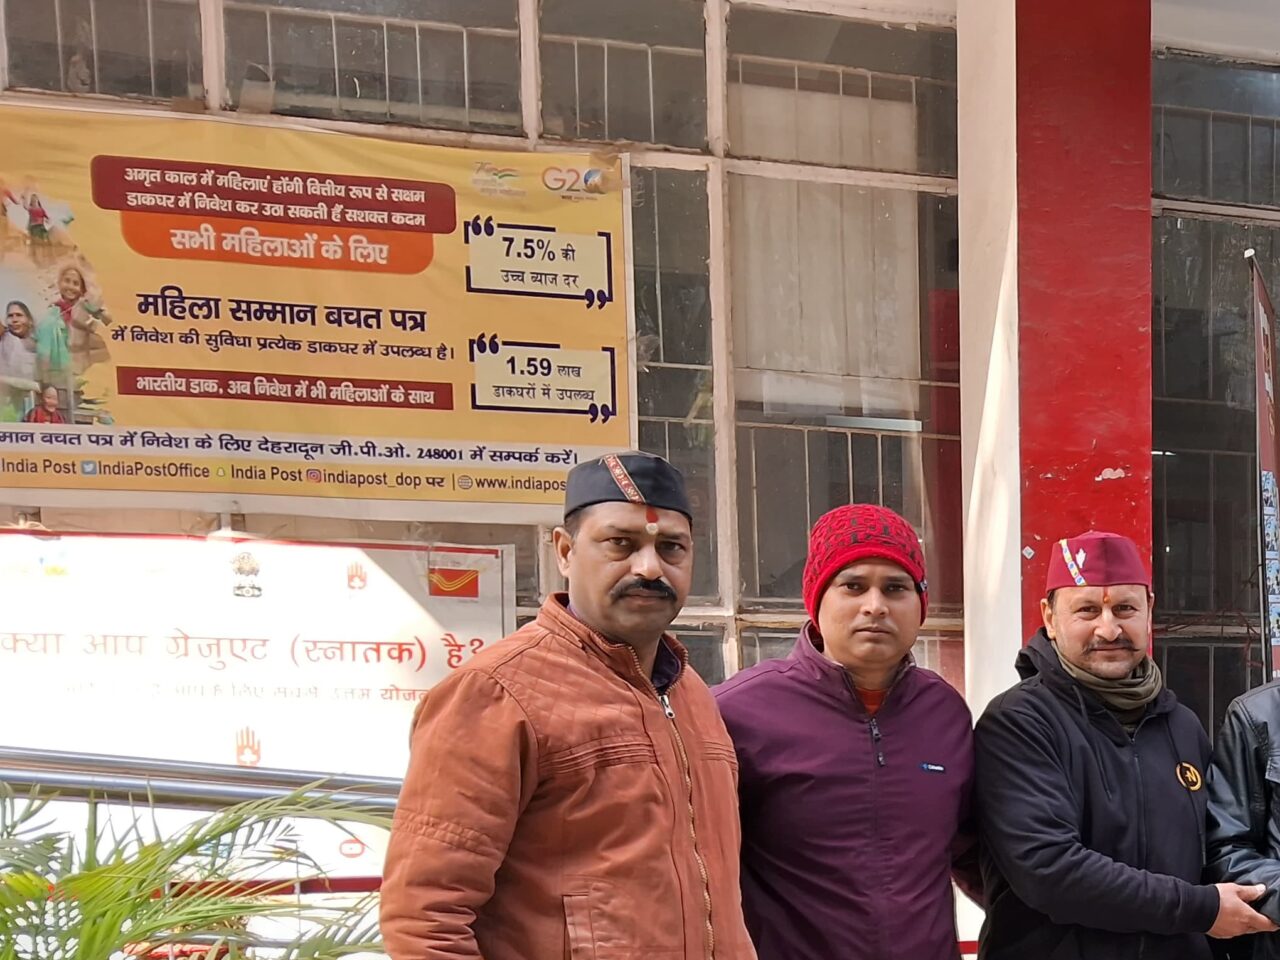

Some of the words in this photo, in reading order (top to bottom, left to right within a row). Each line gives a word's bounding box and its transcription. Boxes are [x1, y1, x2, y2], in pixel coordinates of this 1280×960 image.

[124, 167, 161, 187] अमृत
[164, 170, 197, 186] काल
[199, 169, 215, 187] में
[216, 171, 271, 192] महिलाएं
[272, 176, 304, 195] होंगी
[306, 177, 346, 198] वित्तीय
[348, 185, 373, 200] रूप
[375, 183, 389, 200] से
[390, 188, 426, 203] सक्षम
[126, 191, 176, 208] डाकघर
[177, 191, 193, 209] में
[193, 191, 233, 212] निवेश
[234, 200, 259, 215] कर
[261, 201, 285, 217] उठा
[287, 202, 328, 220] सकती
[331, 203, 344, 222] हैं
[345, 208, 388, 224] सशक्त
[390, 211, 426, 226] कदम
[169, 223, 217, 250] सभी
[221, 227, 319, 258] महिलाओं
[319, 234, 344, 260] के
[348, 234, 390, 265] लिए
[502, 236, 556, 262] 7.5%
[560, 243, 576, 262] की
[500, 269, 526, 284] उच्च
[529, 271, 559, 286] ब्याज
[562, 274, 580, 289] दर
[135, 285, 222, 320] महिला
[227, 299, 318, 327] सम्मान
[323, 305, 383, 330] बचत
[389, 309, 428, 332] पत्र
[111, 325, 128, 342] में
[130, 325, 174, 344] निवेश
[178, 327, 200, 345] की
[204, 329, 252, 352] सुविधा
[256, 334, 303, 351] प्रत्येक
[306, 340, 359, 355] डाकघर
[362, 339, 378, 356] में
[380, 344, 433, 359] उपलब्ध
[506, 356, 552, 377] 1.59
[556, 364, 582, 379] लाख
[136, 371, 187, 392] भारतीय
[227, 380, 251, 395] अब
[253, 376, 292, 398] निवेश
[294, 379, 309, 399] में
[310, 380, 327, 400] भी
[329, 381, 390, 403] महिलाओं
[390, 384, 405, 403] के
[407, 389, 436, 405] साथ
[492, 382, 537, 400] डाकघरों
[540, 383, 553, 400] में
[555, 387, 596, 402] उपलब्ध
[86, 433, 114, 447] पत्र
[119, 430, 138, 447] में
[140, 431, 189, 449] निवेश
[193, 434, 214, 450] के
[218, 433, 253, 452] लिए
[256, 435, 325, 461] देहरादून
[416, 447, 464, 461] 248001
[468, 445, 488, 462] में
[488, 447, 541, 464] सम्पर्क
[1, 458, 39, 474] India
[43, 459, 77, 475] Post
[99, 460, 210, 479] IndiaPostOffice
[231, 464, 267, 481] India
[271, 466, 303, 482] Post
[323, 467, 422, 490] indiapost_dop
[425, 476, 446, 489] पर
[475, 476, 567, 493] www.indiapos
[0, 632, 65, 655] क्या
[83, 633, 148, 656] आप
[164, 627, 270, 671] ग्रेजुएट
[290, 633, 427, 673] (स्नातक)
